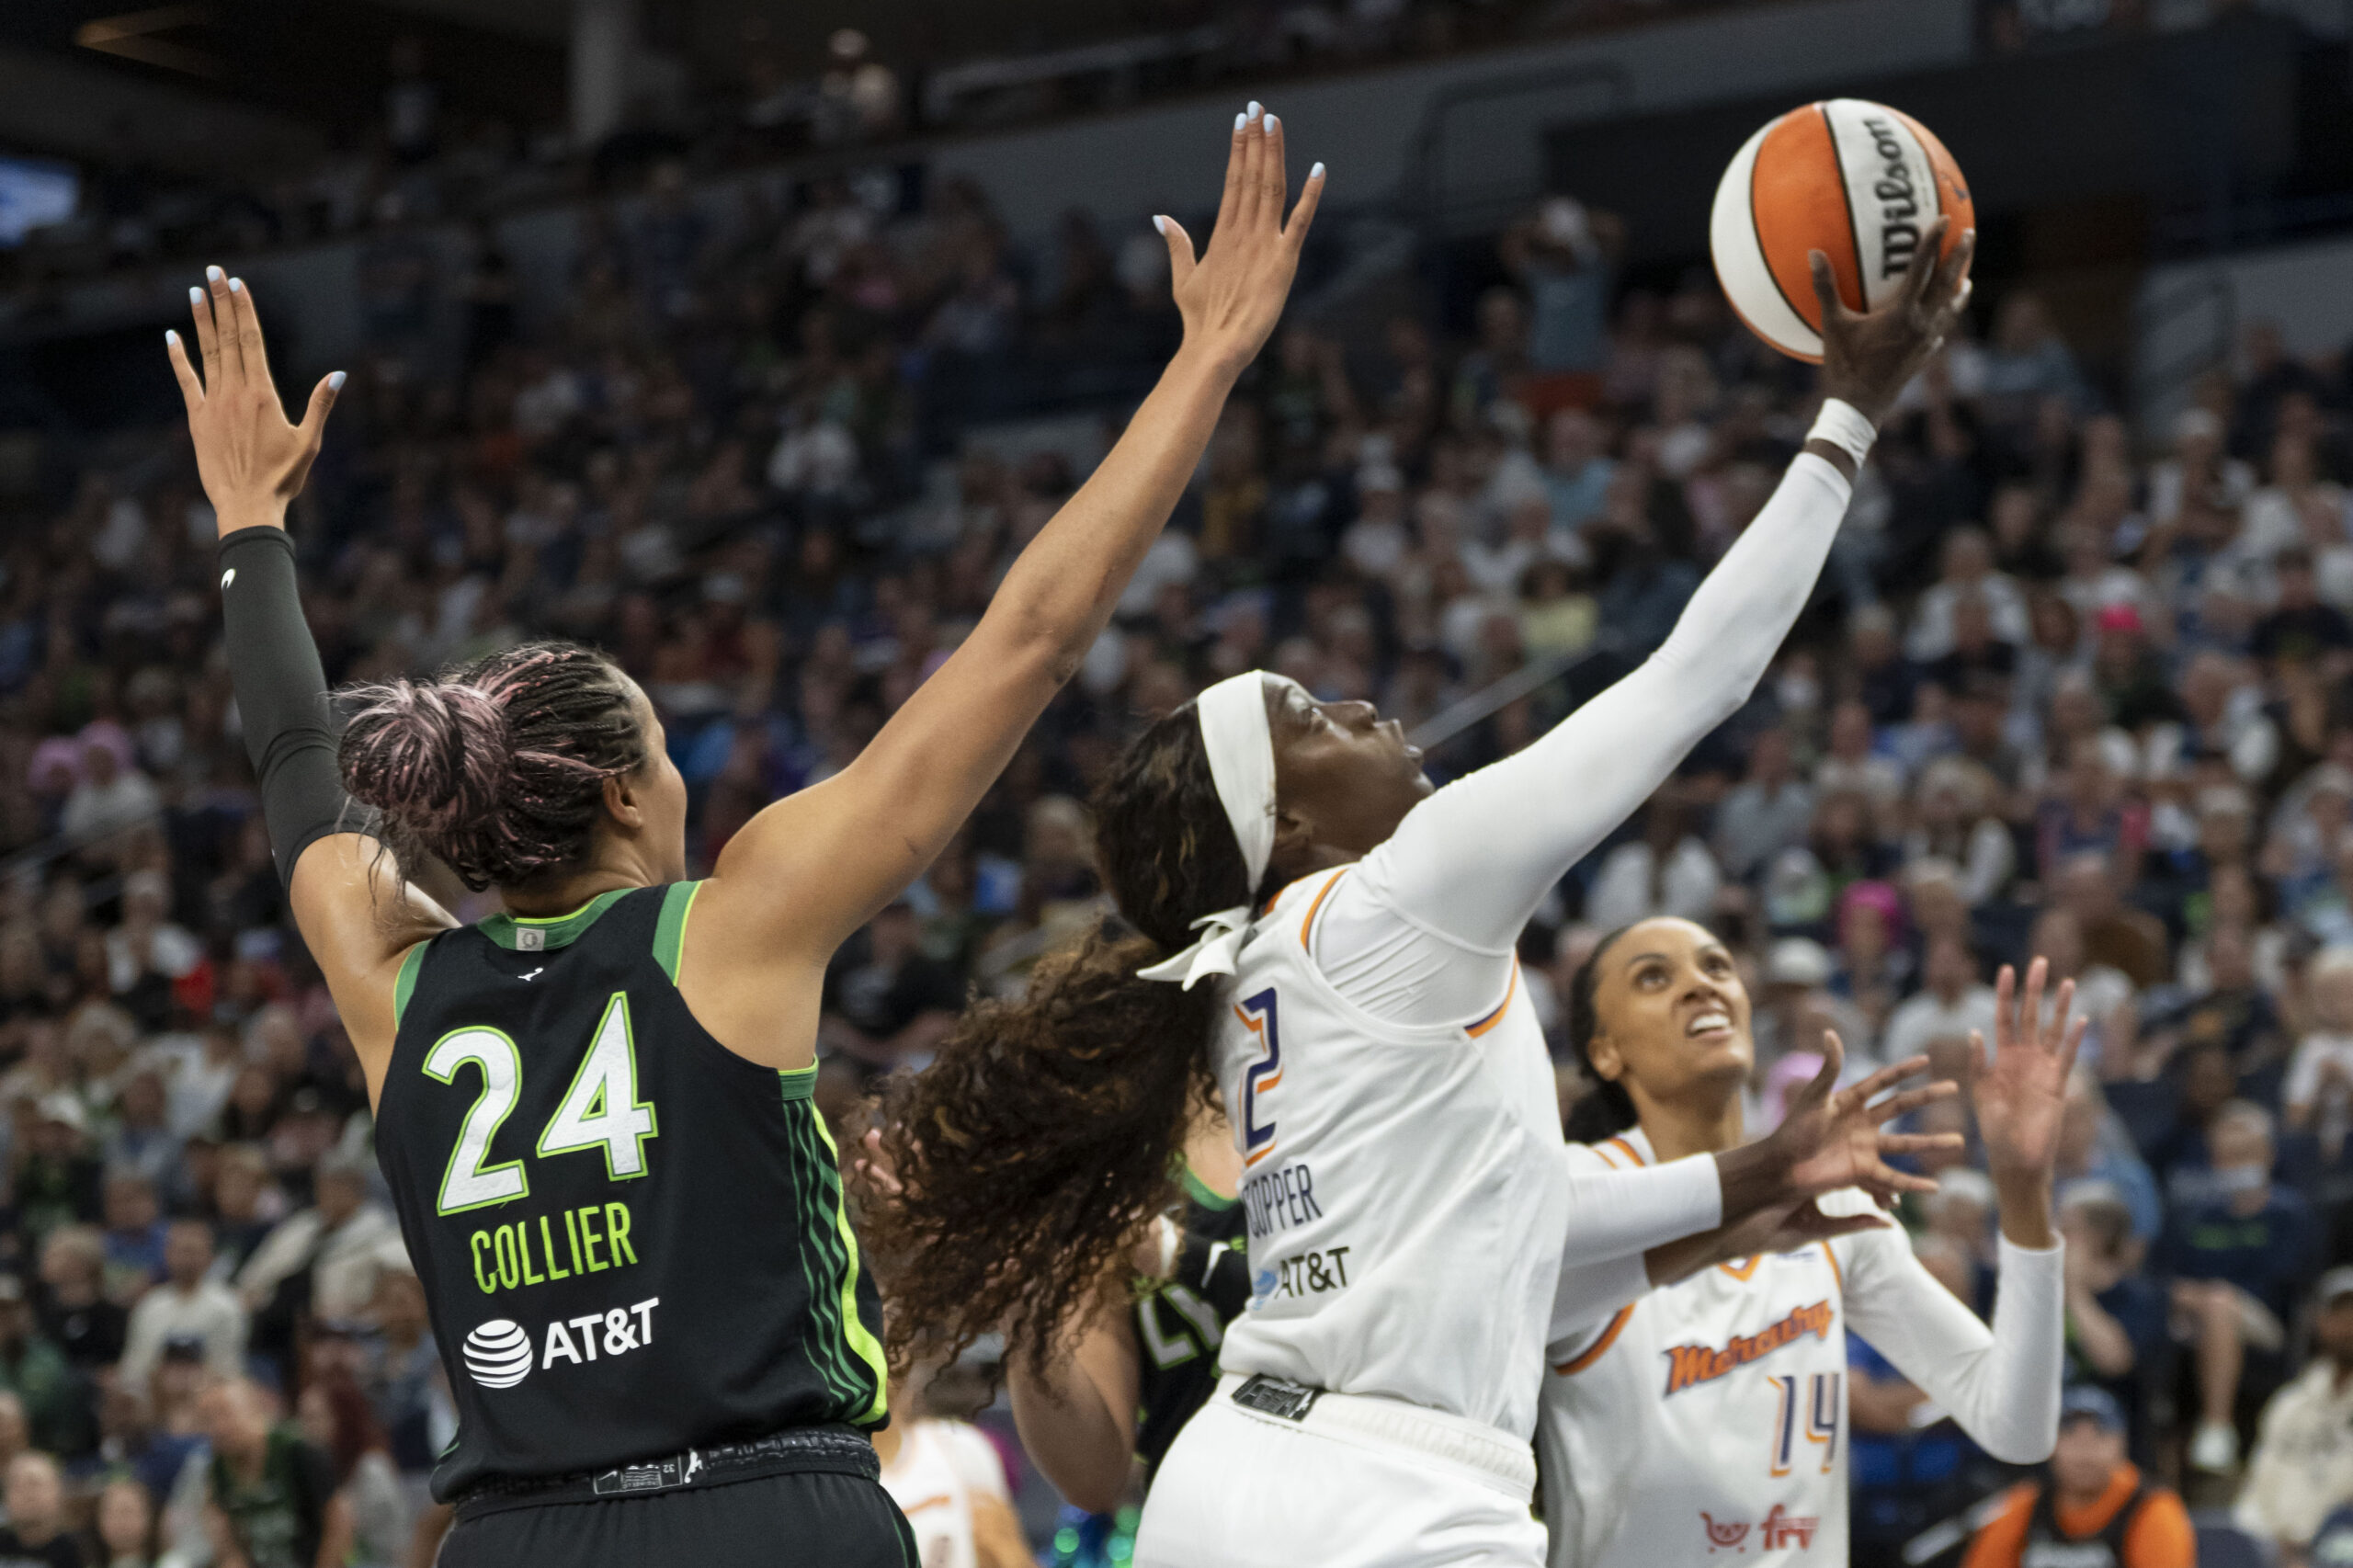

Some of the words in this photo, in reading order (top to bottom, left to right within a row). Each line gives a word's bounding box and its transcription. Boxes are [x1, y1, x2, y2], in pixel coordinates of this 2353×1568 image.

[1862, 117, 1920, 280] Wilson
[422, 991, 658, 1217] 24
[1233, 987, 1285, 1168] 2
[471, 1202, 639, 1294] COLLIER
[1274, 1246, 1350, 1300] AT&T
[541, 1297, 660, 1370] AT&T
[1662, 1299, 1835, 1400] Mercury
[1767, 1373, 1839, 1477] 14
